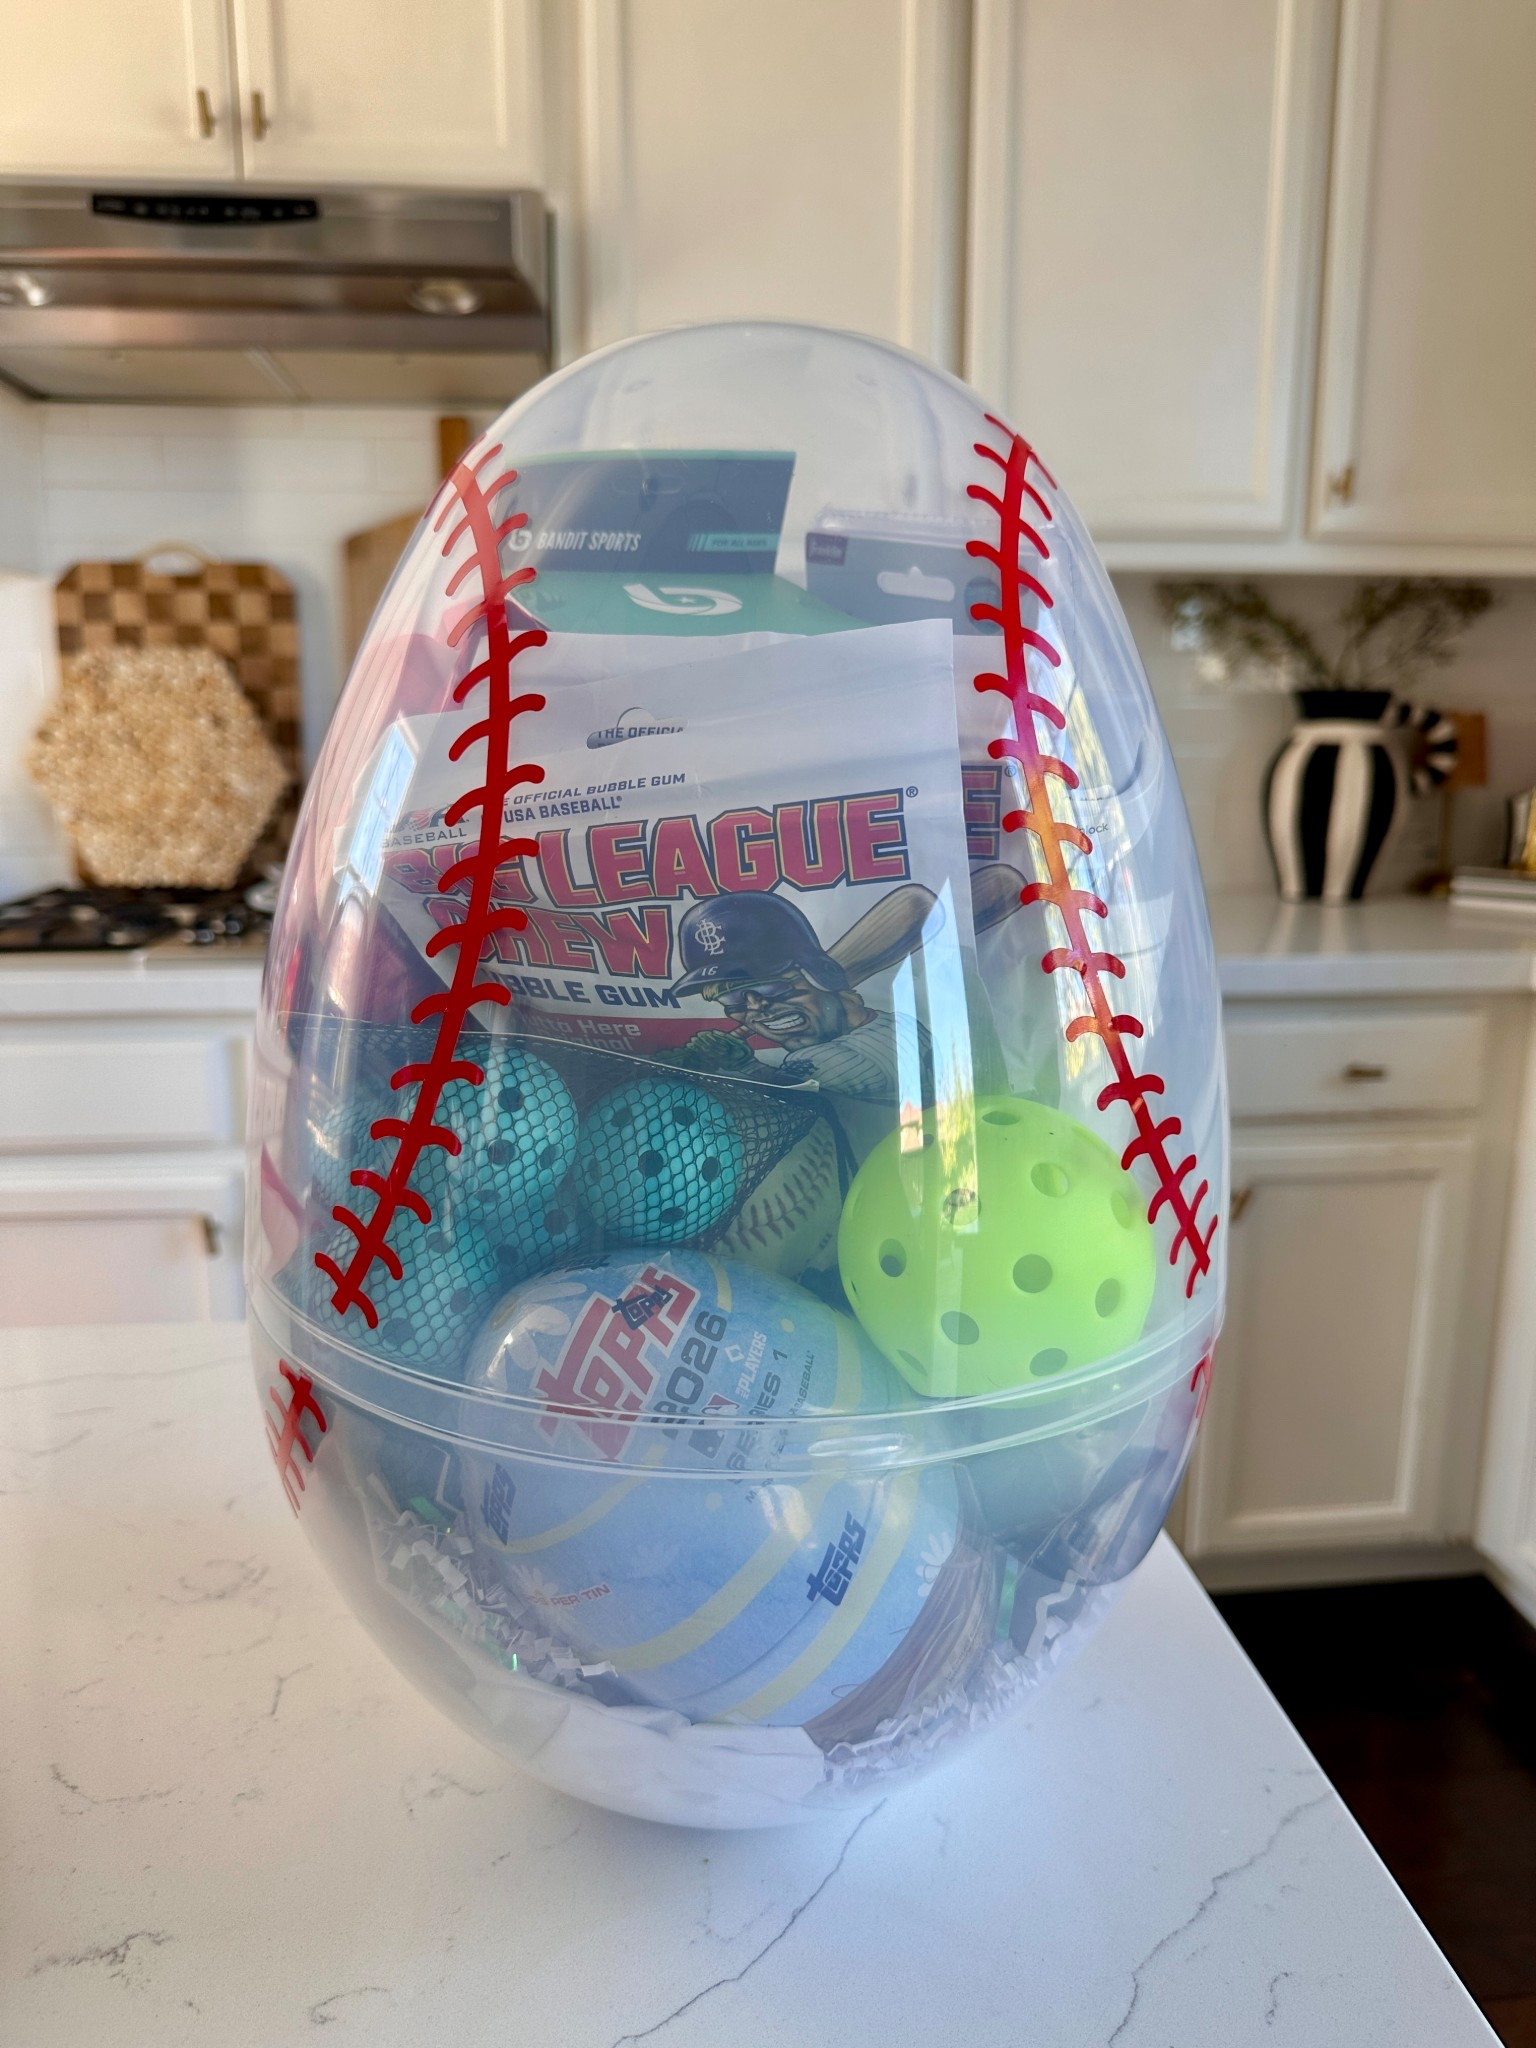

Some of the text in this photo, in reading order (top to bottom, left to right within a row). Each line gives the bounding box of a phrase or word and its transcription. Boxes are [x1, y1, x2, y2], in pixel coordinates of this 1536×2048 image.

[537, 530, 641, 552] BANDIT SPORTS
[513, 788, 582, 806] OFFICIAL
[587, 777, 646, 796] BUBBLE
[650, 773, 686, 787] GUM
[504, 808, 536, 824] USA
[701, 965, 719, 977] 16
[482, 968, 682, 1009] BBLE GUM
[521, 1014, 641, 1037] utta Here
[738, 1331, 768, 1394] PLAYERS
[772, 1349, 788, 1361] 1
[581, 1583, 611, 1600] TIN
